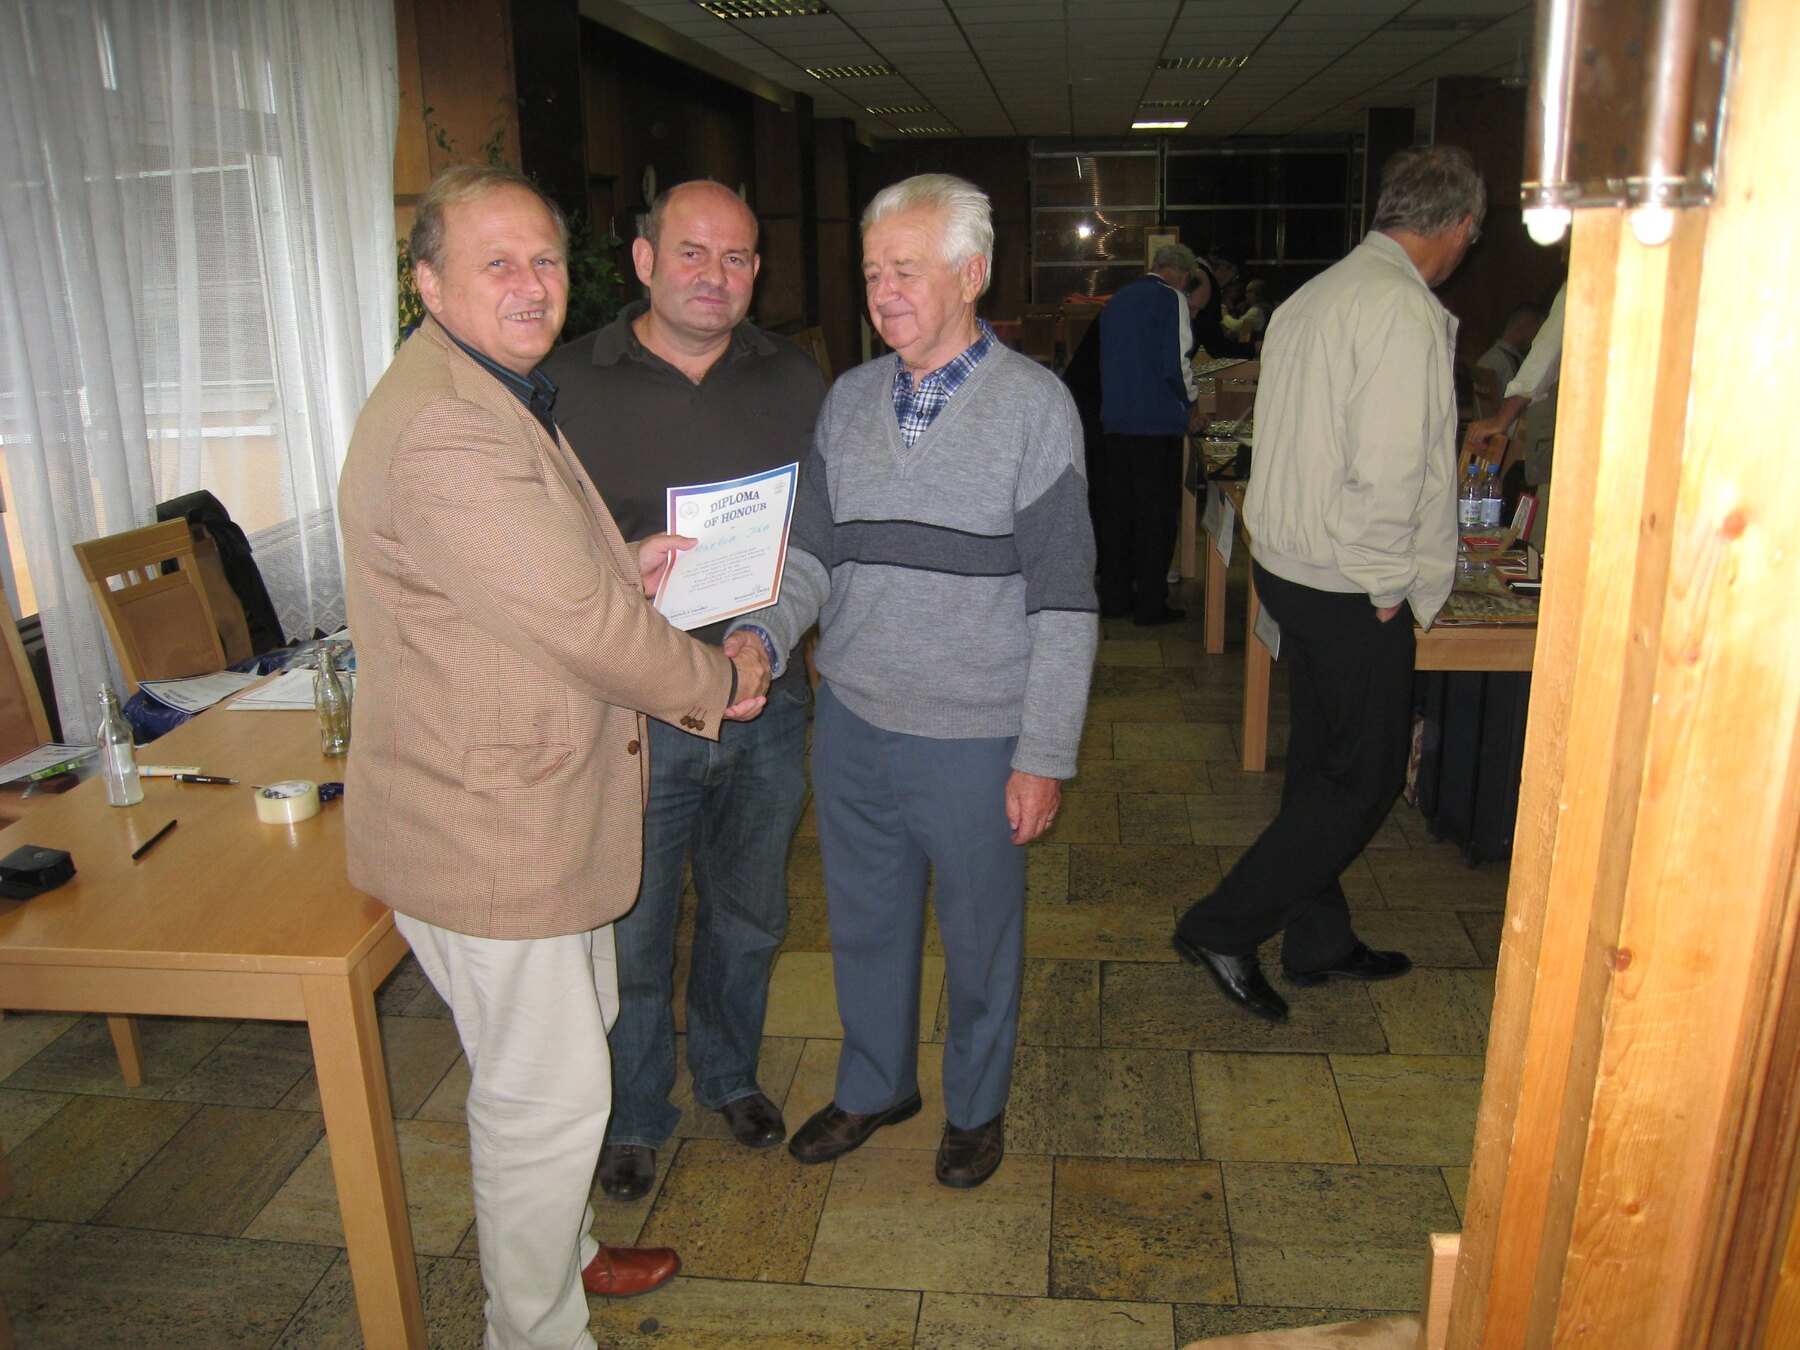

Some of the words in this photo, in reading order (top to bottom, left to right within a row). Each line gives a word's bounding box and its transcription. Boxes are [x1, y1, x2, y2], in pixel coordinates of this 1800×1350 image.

[710, 490, 760, 513] DIPLOMA
[703, 516, 719, 529] OF
[720, 502, 767, 524] HONOUR
